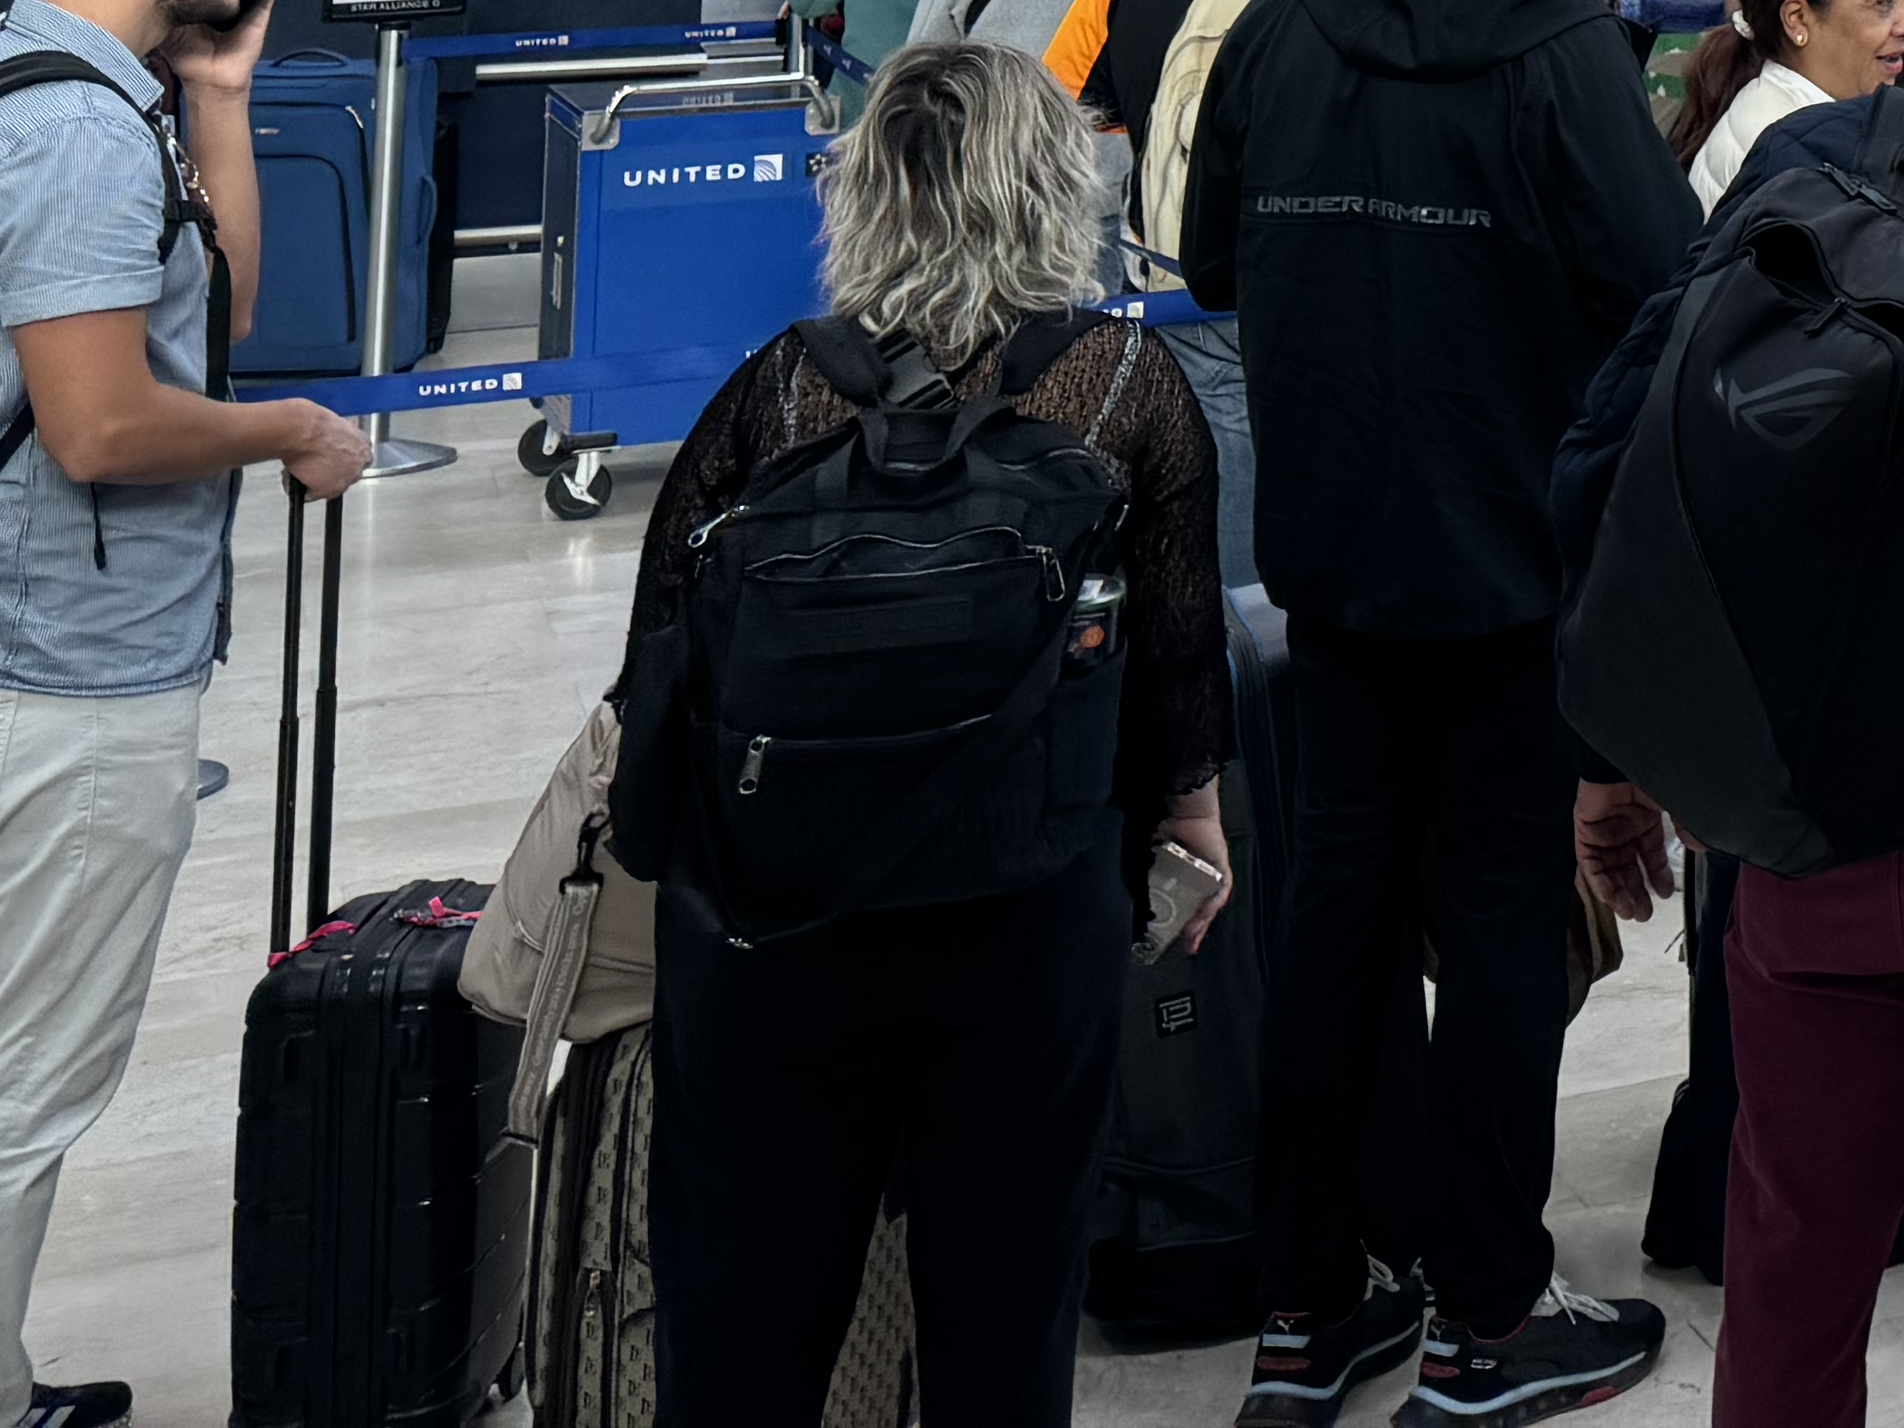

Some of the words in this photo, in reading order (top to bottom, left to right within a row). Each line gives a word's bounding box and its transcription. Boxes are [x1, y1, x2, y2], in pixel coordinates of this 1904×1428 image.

[351, 4, 377, 12] STAR
[380, 0, 429, 10] ALLIANCE
[685, 29, 724, 38] UNITED
[515, 37, 557, 47] UNITED
[623, 162, 746, 187] UNITED
[1256, 195, 1365, 214] UNDER
[1367, 198, 1493, 228] ARMOUR
[419, 377, 498, 397] UNITED
